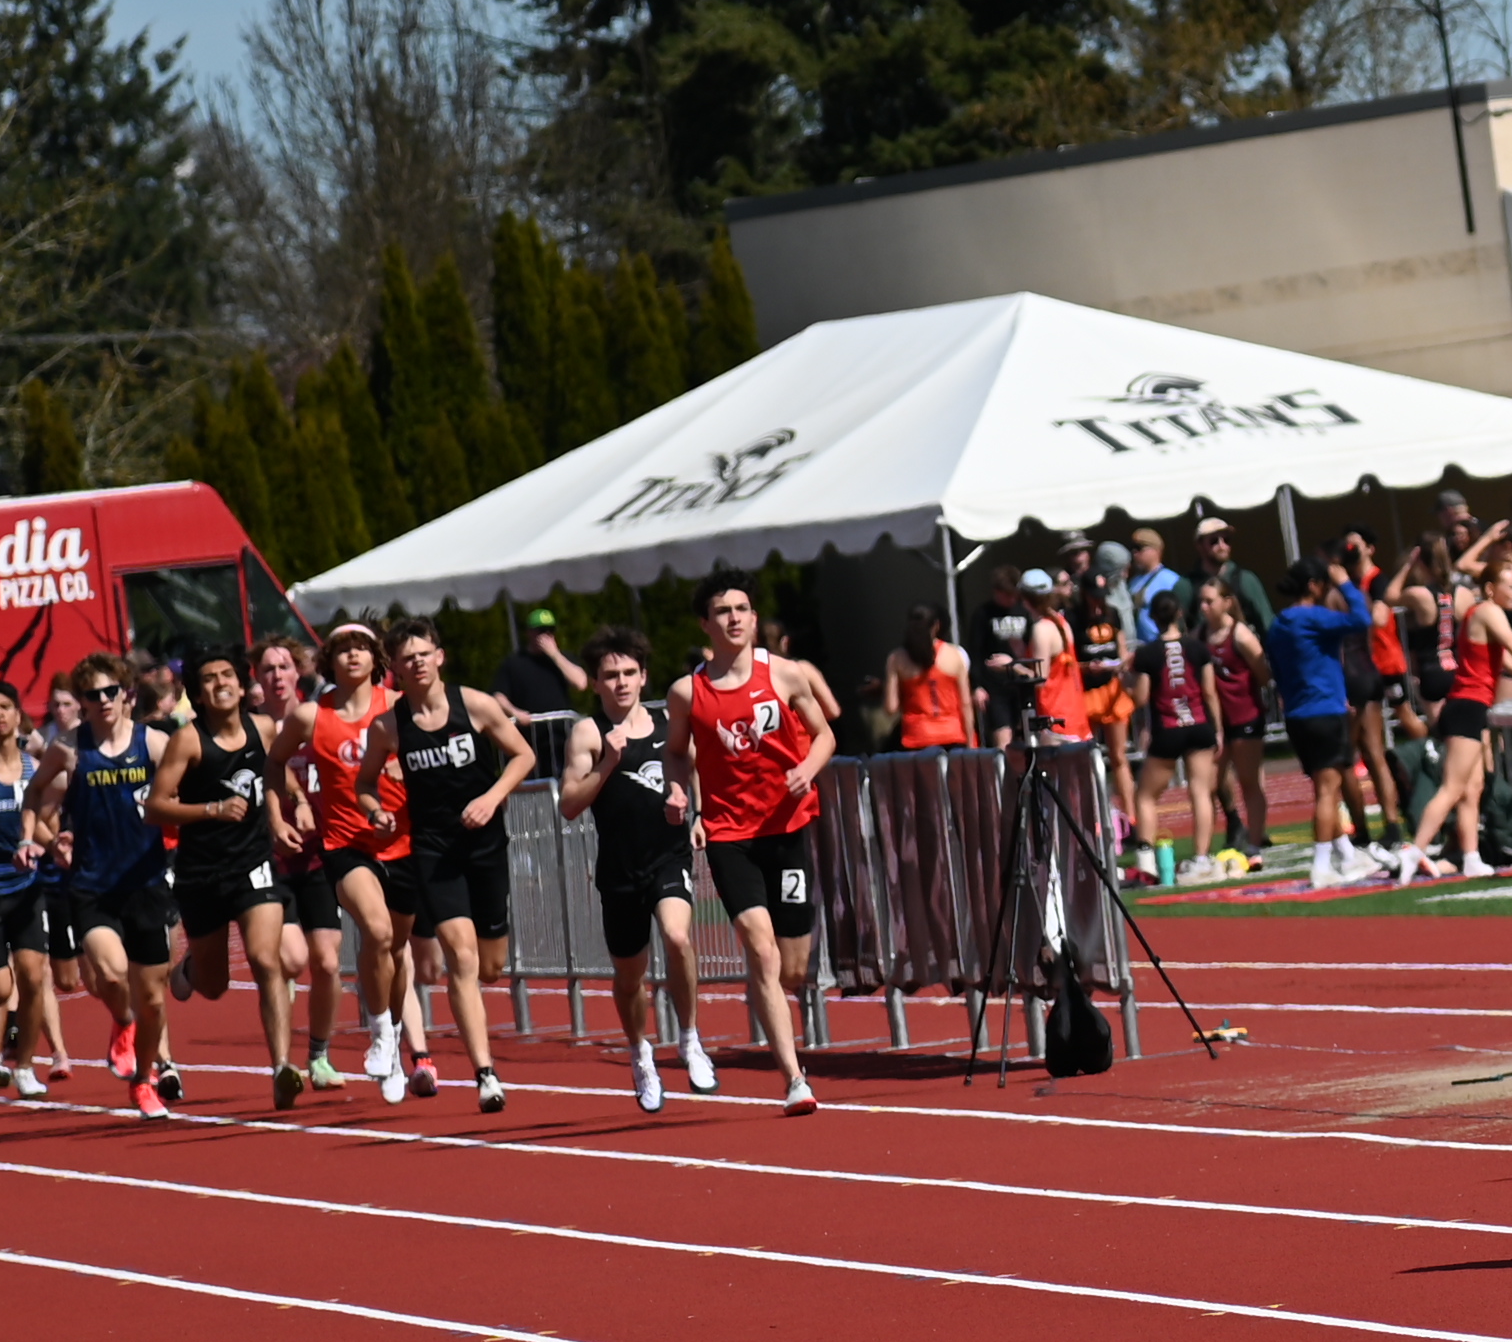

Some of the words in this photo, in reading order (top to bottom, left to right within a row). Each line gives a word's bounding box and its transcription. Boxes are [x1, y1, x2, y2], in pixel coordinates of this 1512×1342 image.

[1051, 389, 1361, 454] TITANS
[59, 571, 95, 602] CO.
[759, 705, 775, 731] 2
[454, 739, 471, 763] 5
[786, 873, 800, 899] 2
